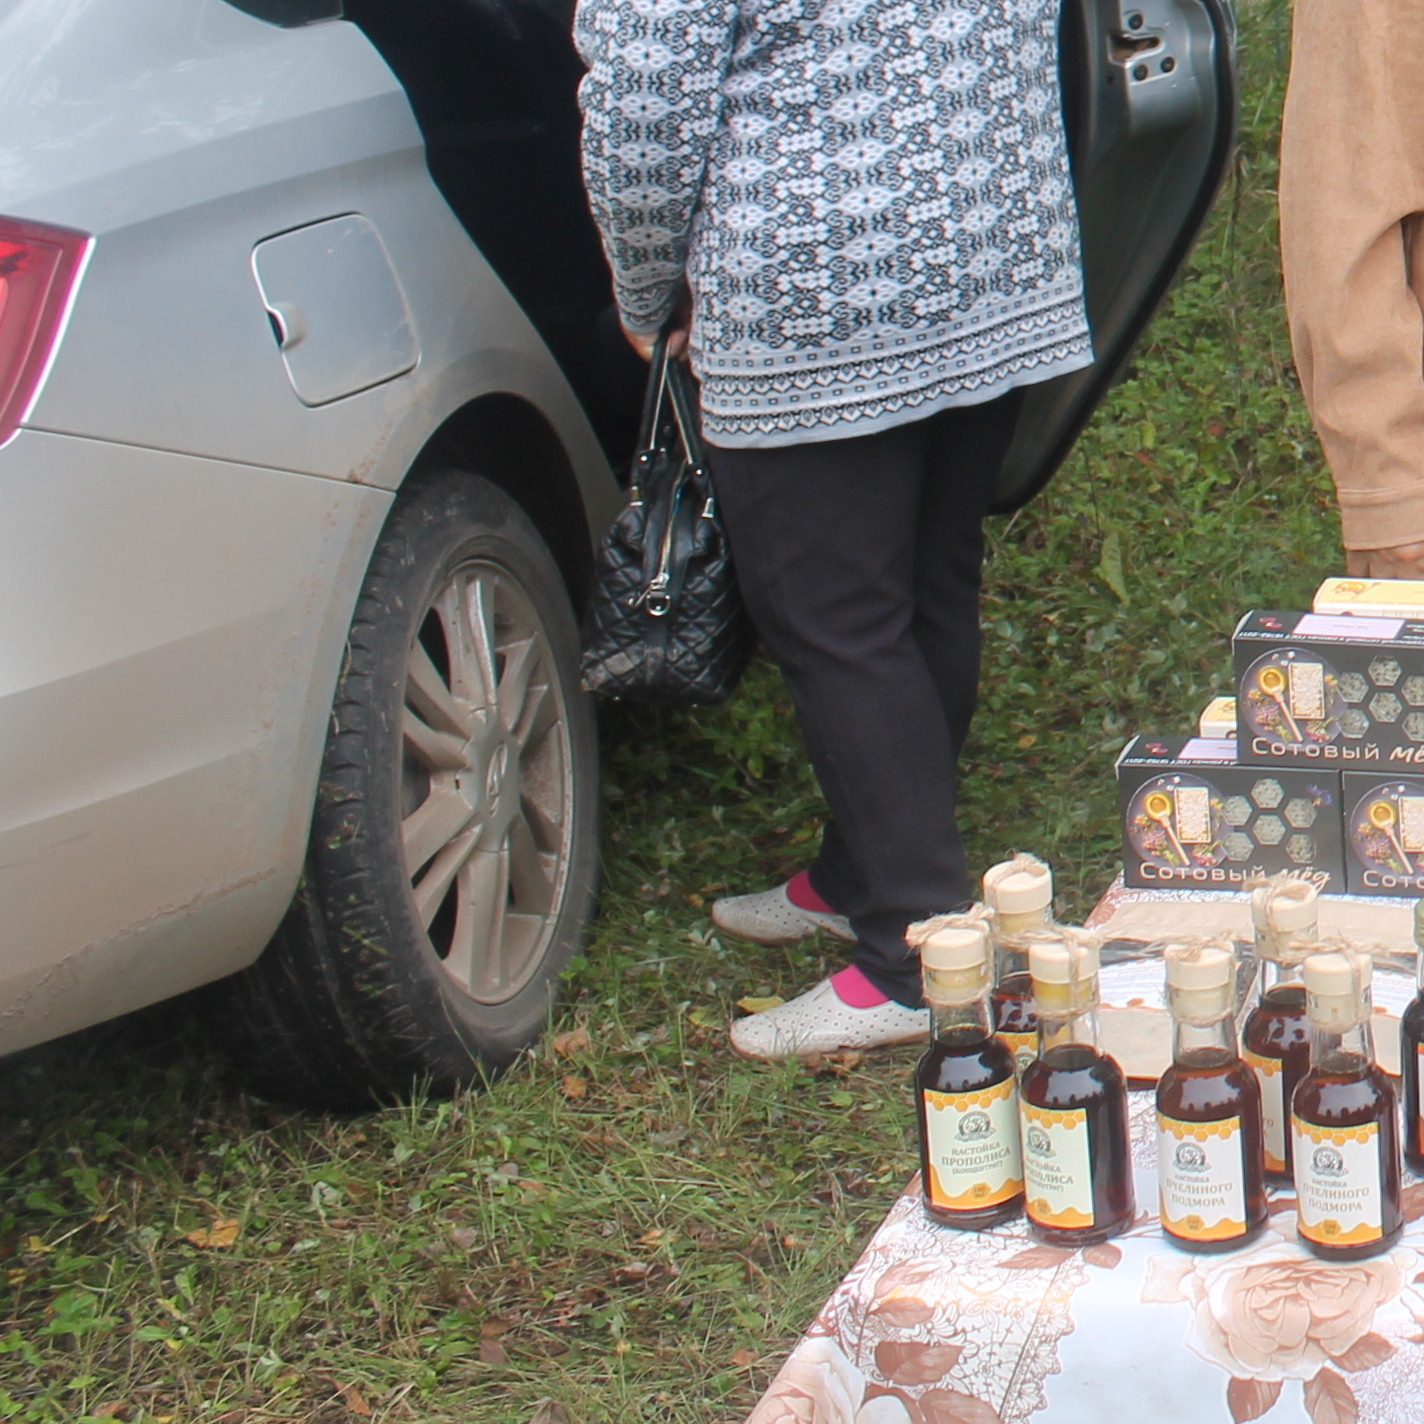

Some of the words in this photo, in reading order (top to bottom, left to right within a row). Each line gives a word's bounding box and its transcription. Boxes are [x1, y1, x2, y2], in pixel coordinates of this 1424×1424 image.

[1252, 737, 1380, 760] Сотовый
[1140, 862, 1265, 882] Сотовый
[941, 1146, 1012, 1167] ПРОПОЛИСА
[952, 1141, 1001, 1155] НАСТОЙКА
[1166, 1178, 1233, 1195] ПЧЕЛИНОГО
[1303, 1183, 1370, 1200] ПЧЕЛИНОГО
[1172, 1193, 1226, 1208] ПОДМОРА
[1308, 1198, 1363, 1213] ПОДМОРА
